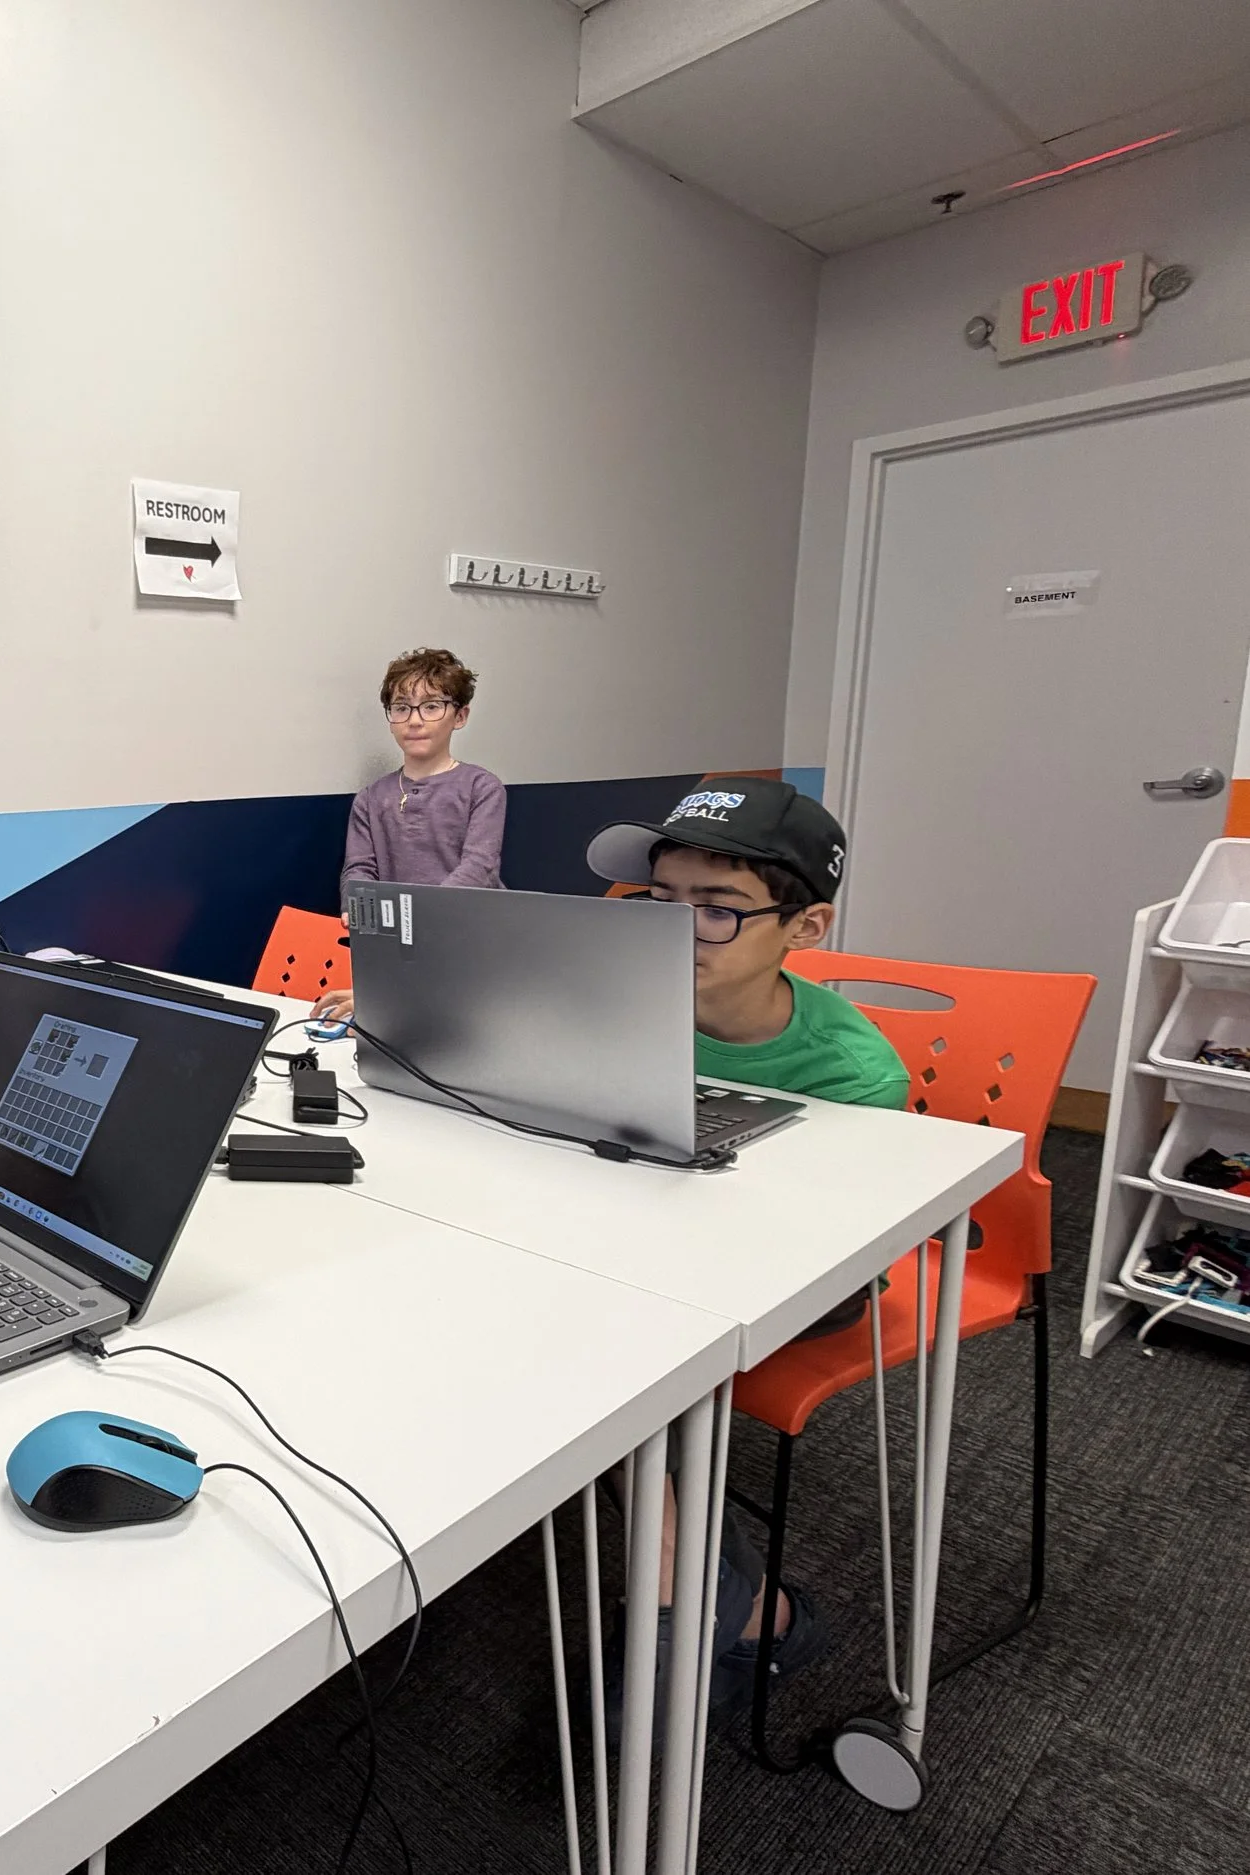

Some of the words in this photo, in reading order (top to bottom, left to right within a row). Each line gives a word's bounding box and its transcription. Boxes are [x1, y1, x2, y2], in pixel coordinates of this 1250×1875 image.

[1020, 259, 1125, 345] EXIT
[146, 499, 226, 525] RESTROOM
[1014, 591, 1077, 604] BASEMENT
[827, 844, 845, 878] 3
